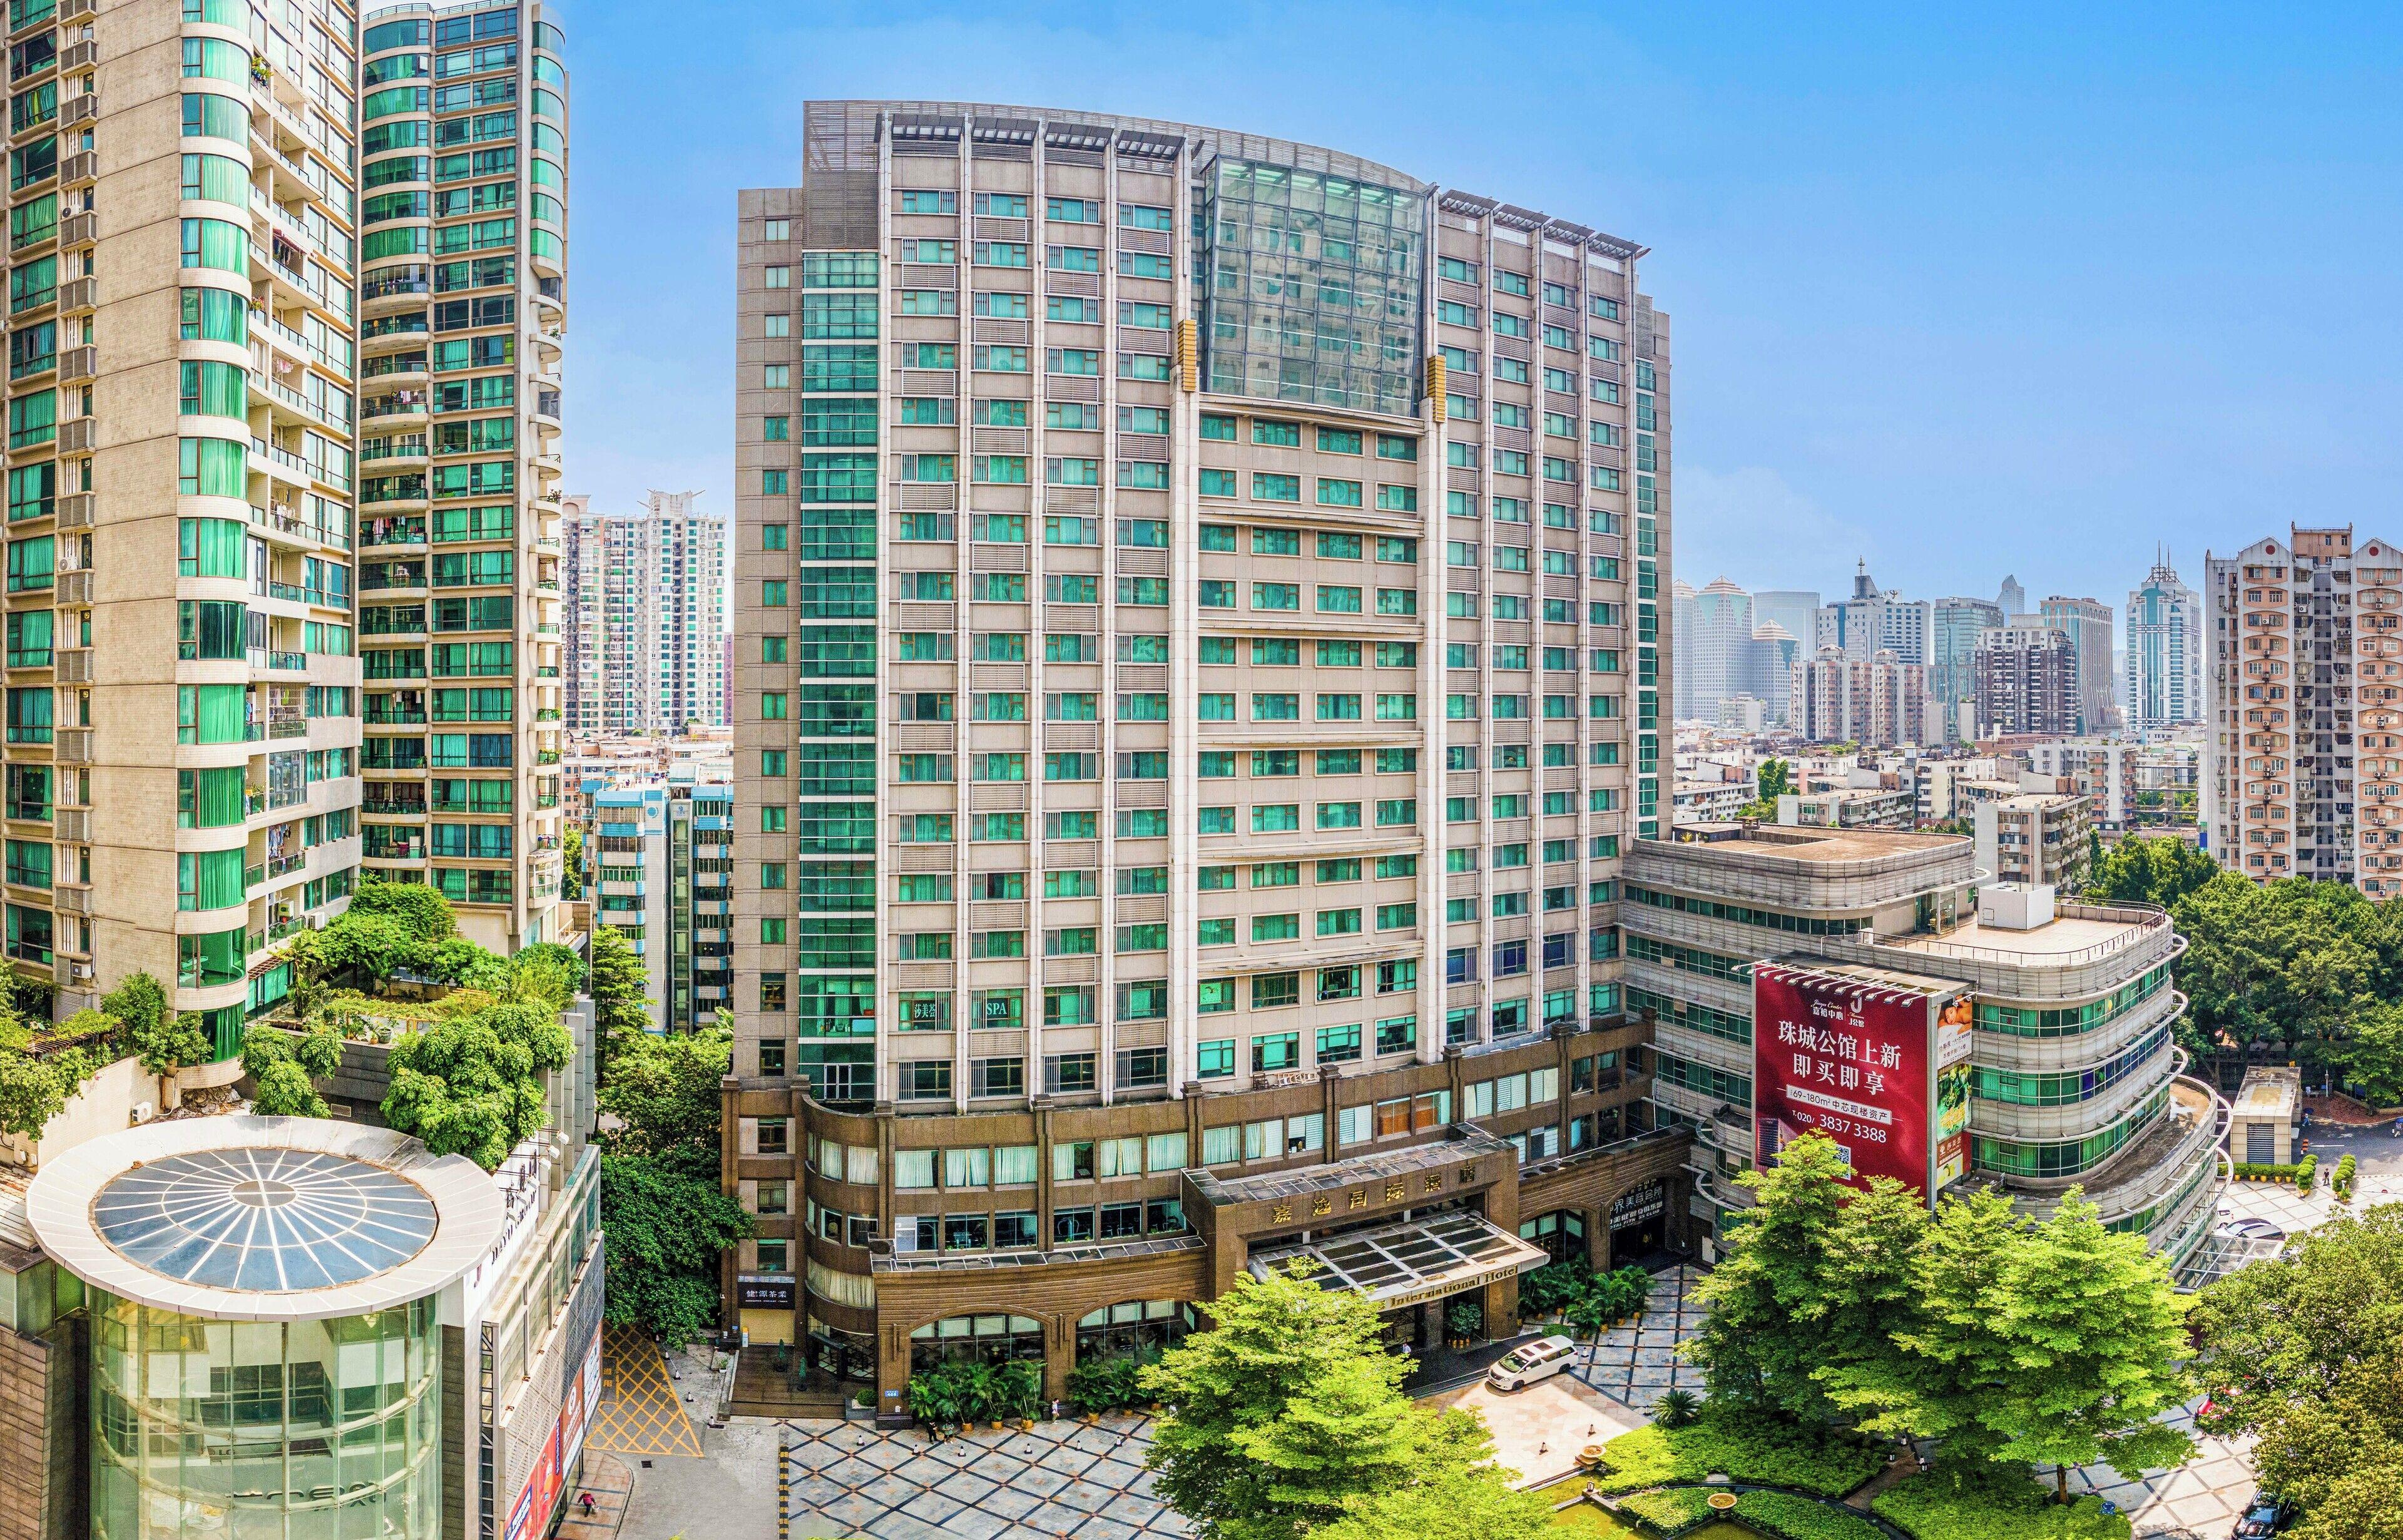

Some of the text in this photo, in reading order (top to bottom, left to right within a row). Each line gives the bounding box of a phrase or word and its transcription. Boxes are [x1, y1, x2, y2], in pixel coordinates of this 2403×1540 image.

[987, 1002, 1007, 1016] SPA
[1778, 1020, 1901, 1070] 珠城公馆上新
[1793, 1053, 1885, 1095] 即买即享
[1820, 1114, 1850, 1133] 3837
[1854, 1123, 1887, 1143] 3388
[1832, 1100, 1887, 1120] 中芯现楼资产
[1273, 1165, 1476, 1223] 嘉逸国际酒店
[1390, 1275, 1481, 1308] International
[1484, 1264, 1518, 1283] Hotel
